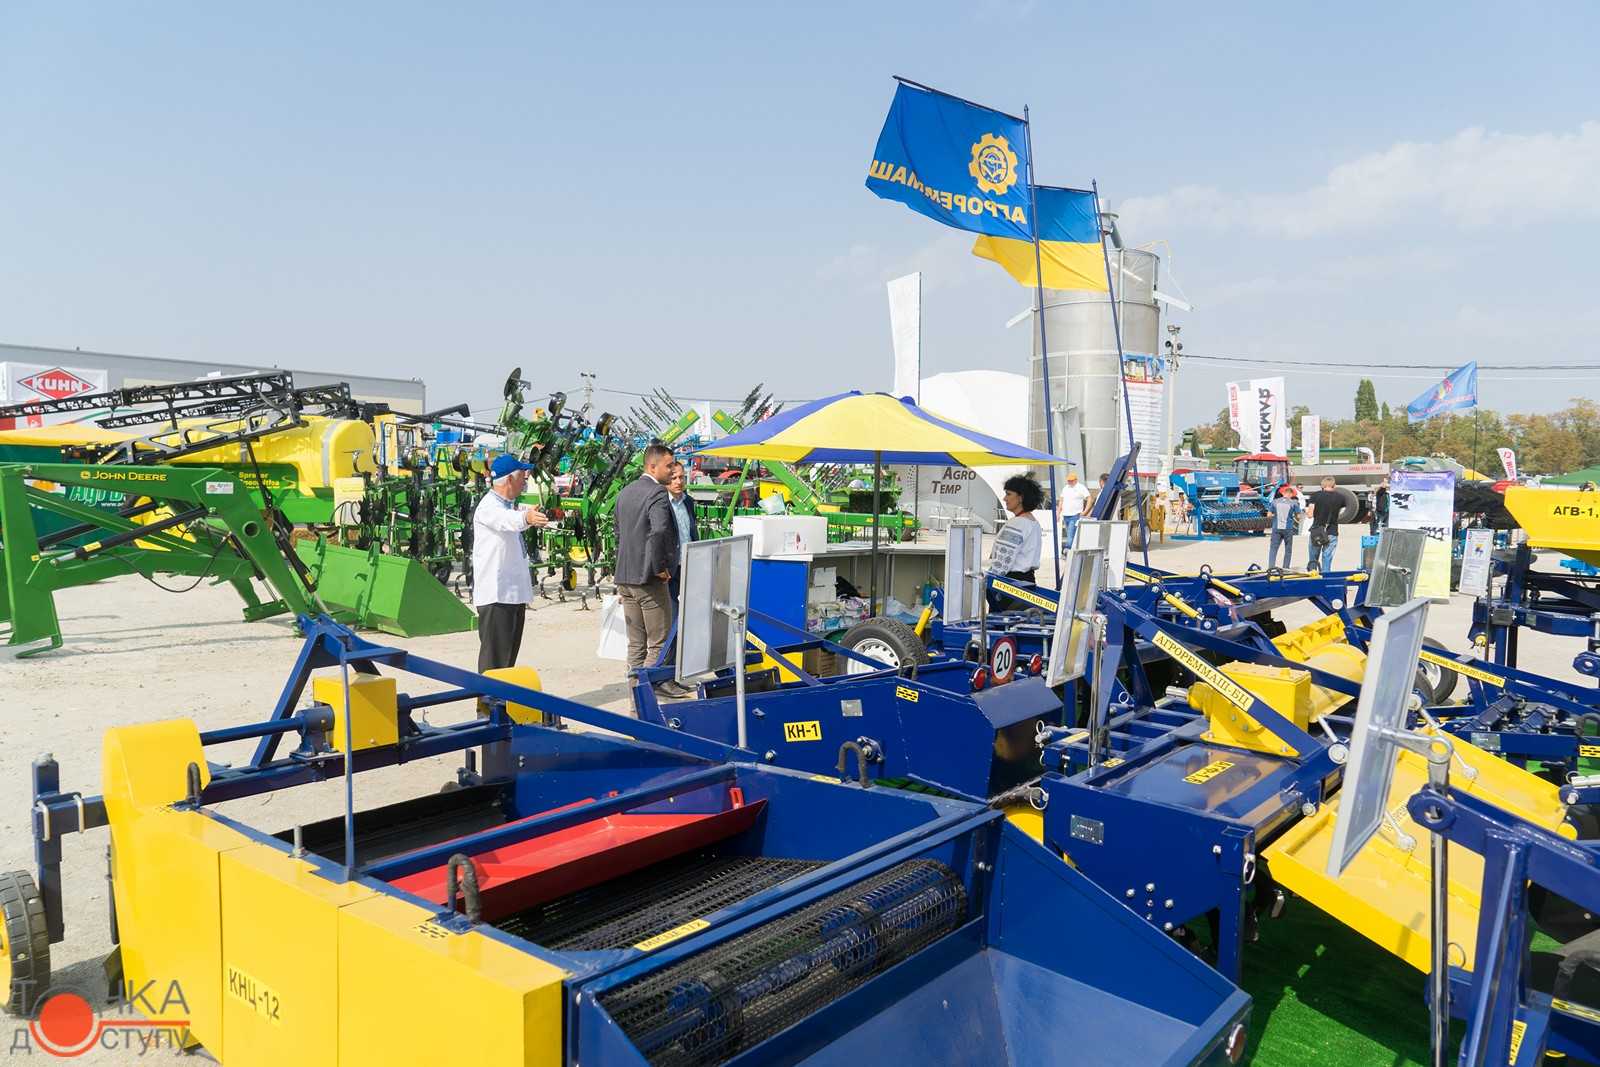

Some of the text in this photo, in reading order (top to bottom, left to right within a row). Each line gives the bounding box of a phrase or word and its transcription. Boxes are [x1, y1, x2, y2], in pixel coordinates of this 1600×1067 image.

[32, 376, 83, 392] KUHN
[1259, 388, 1273, 452] MECMAR
[92, 471, 168, 481] JOHN DEERE
[995, 648, 1011, 674] 20
[1156, 635, 1251, 708] АГРОРЕММАШ-БЦ
[786, 723, 819, 739] КН-1
